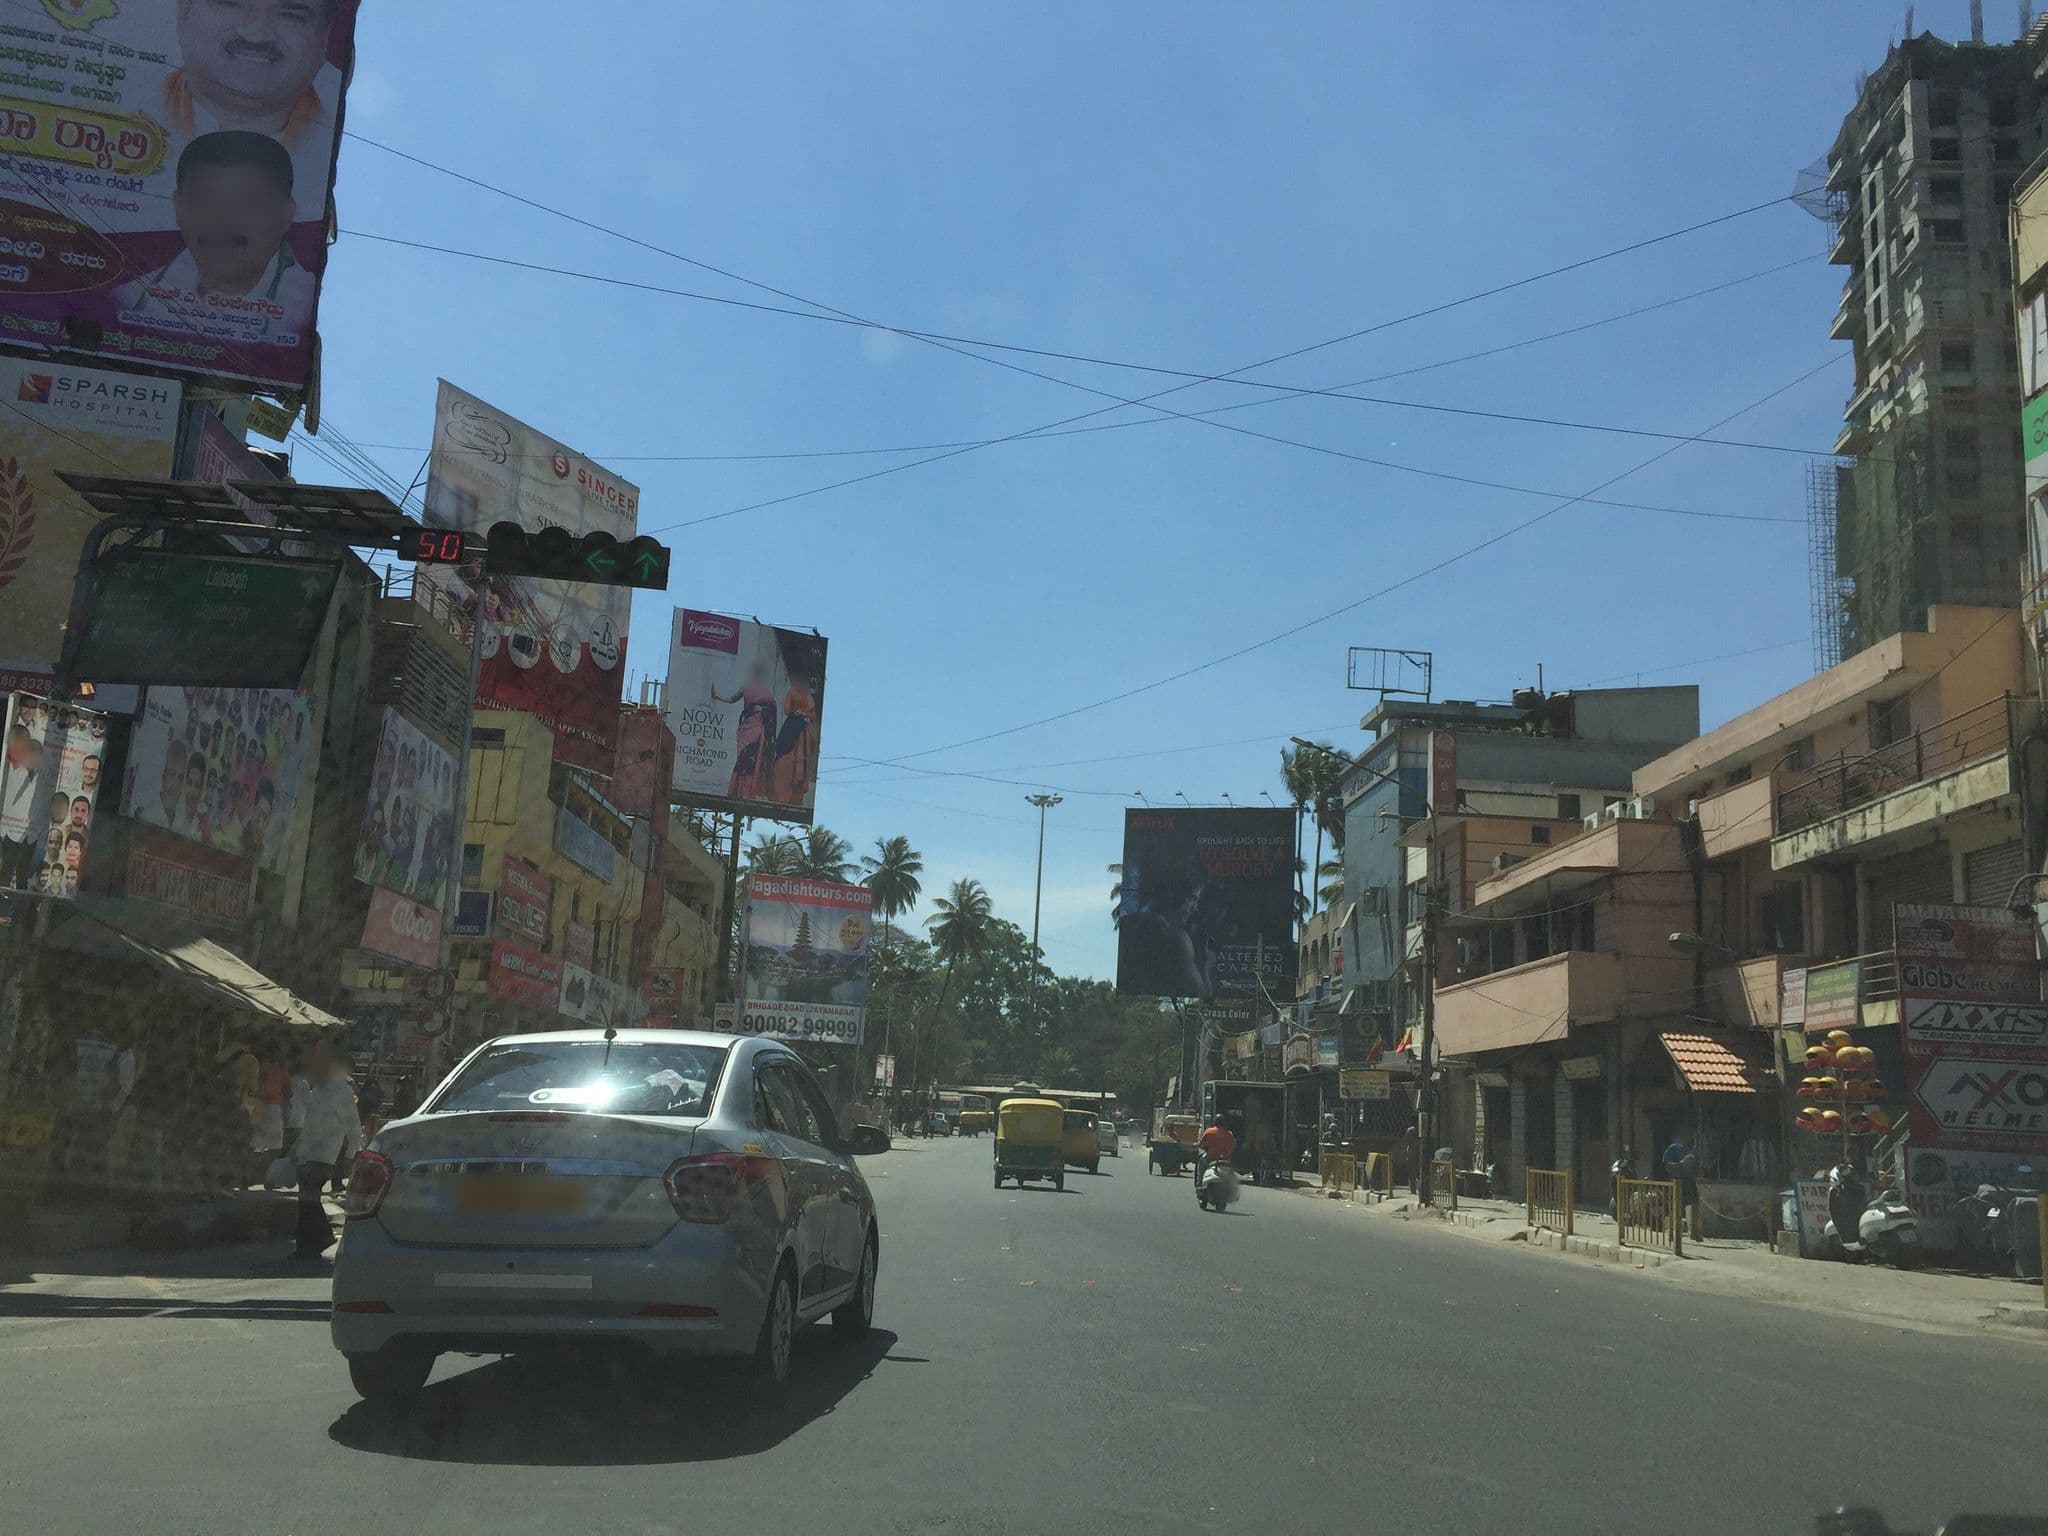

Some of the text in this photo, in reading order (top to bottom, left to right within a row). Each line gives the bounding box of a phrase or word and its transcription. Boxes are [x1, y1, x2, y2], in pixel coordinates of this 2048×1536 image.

[57, 377, 168, 403] SPARSH
[53, 398, 164, 420] HOSPITAL
[577, 468, 635, 513] SINGER
[417, 533, 462, 560] 50
[205, 566, 248, 592] Lalbagh
[683, 708, 727, 727] NOW
[680, 722, 724, 741] OPEN
[675, 745, 728, 761] RICHMOND
[686, 755, 713, 767] ROAD
[1902, 964, 1968, 989] Globe
[748, 1001, 782, 1012] BRIGADE
[809, 1005, 855, 1018] JAYANAGAR
[743, 1014, 858, 1038] 90082 99999
